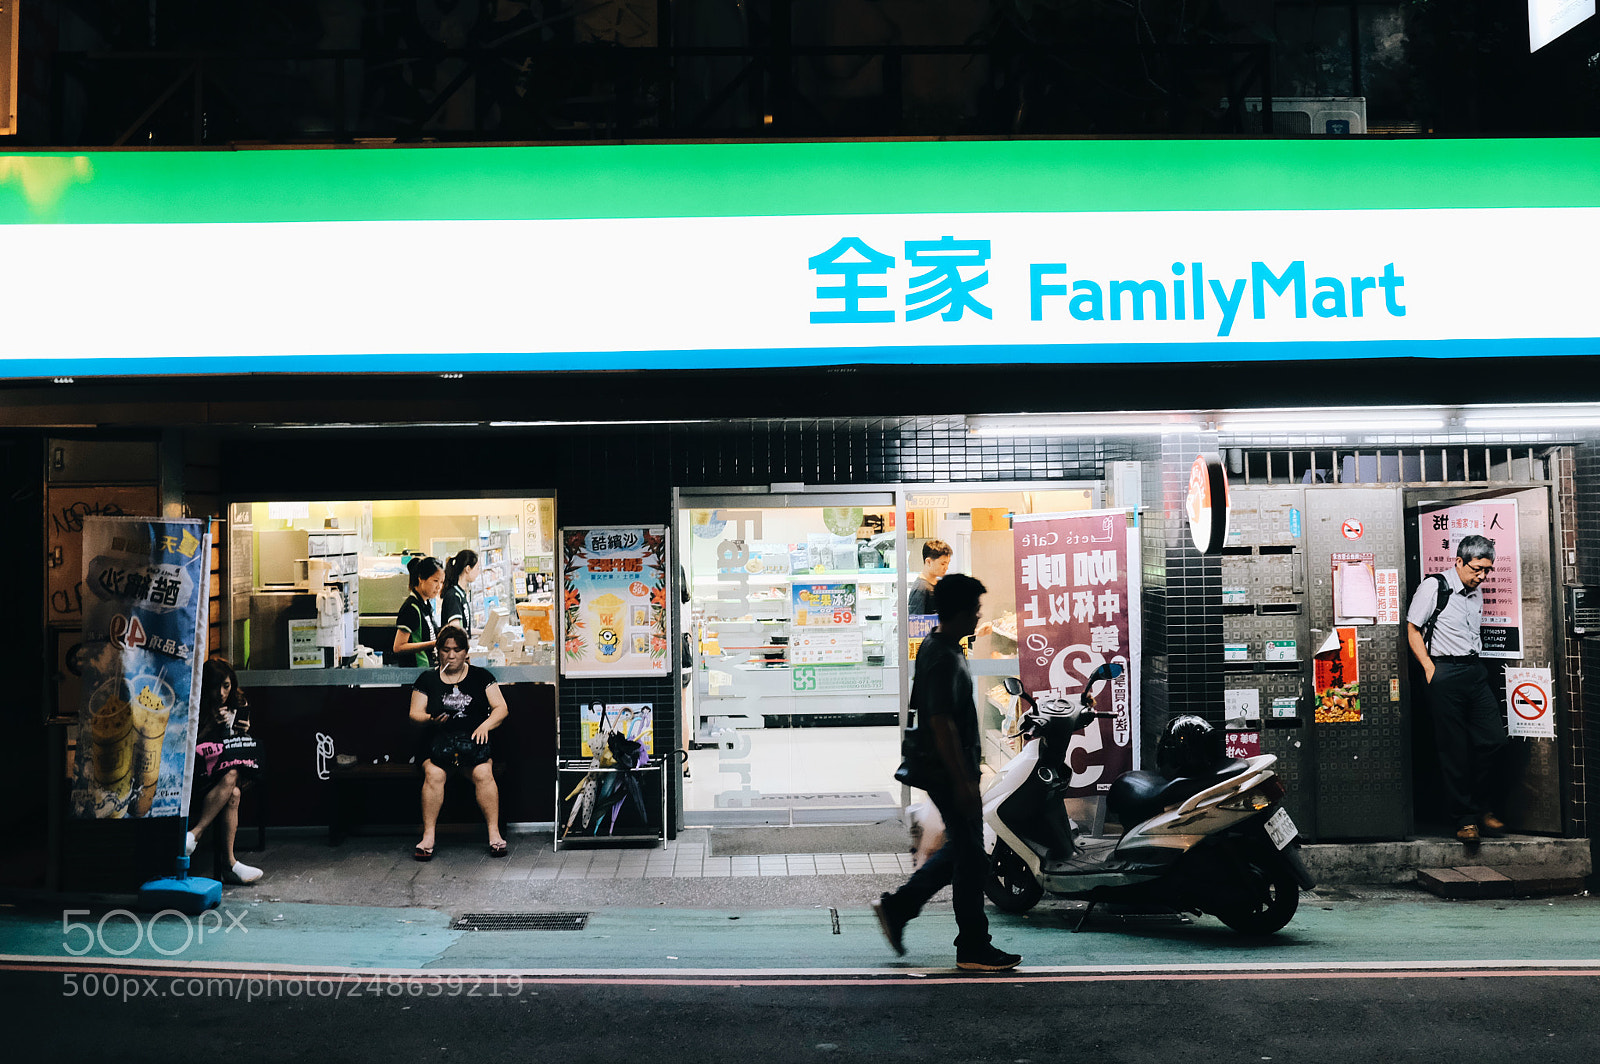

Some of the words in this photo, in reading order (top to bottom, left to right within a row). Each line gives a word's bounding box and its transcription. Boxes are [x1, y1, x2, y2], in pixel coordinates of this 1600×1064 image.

[808, 236, 992, 324] 全家
[1030, 261, 1406, 336] FamilyMart
[591, 532, 639, 551] 酷繽沙
[809, 594, 855, 607] 芒果冰沙
[1377, 572, 1388, 622] 違者拖吊
[1388, 572, 1398, 622] 請留通道
[833, 611, 852, 624] 59
